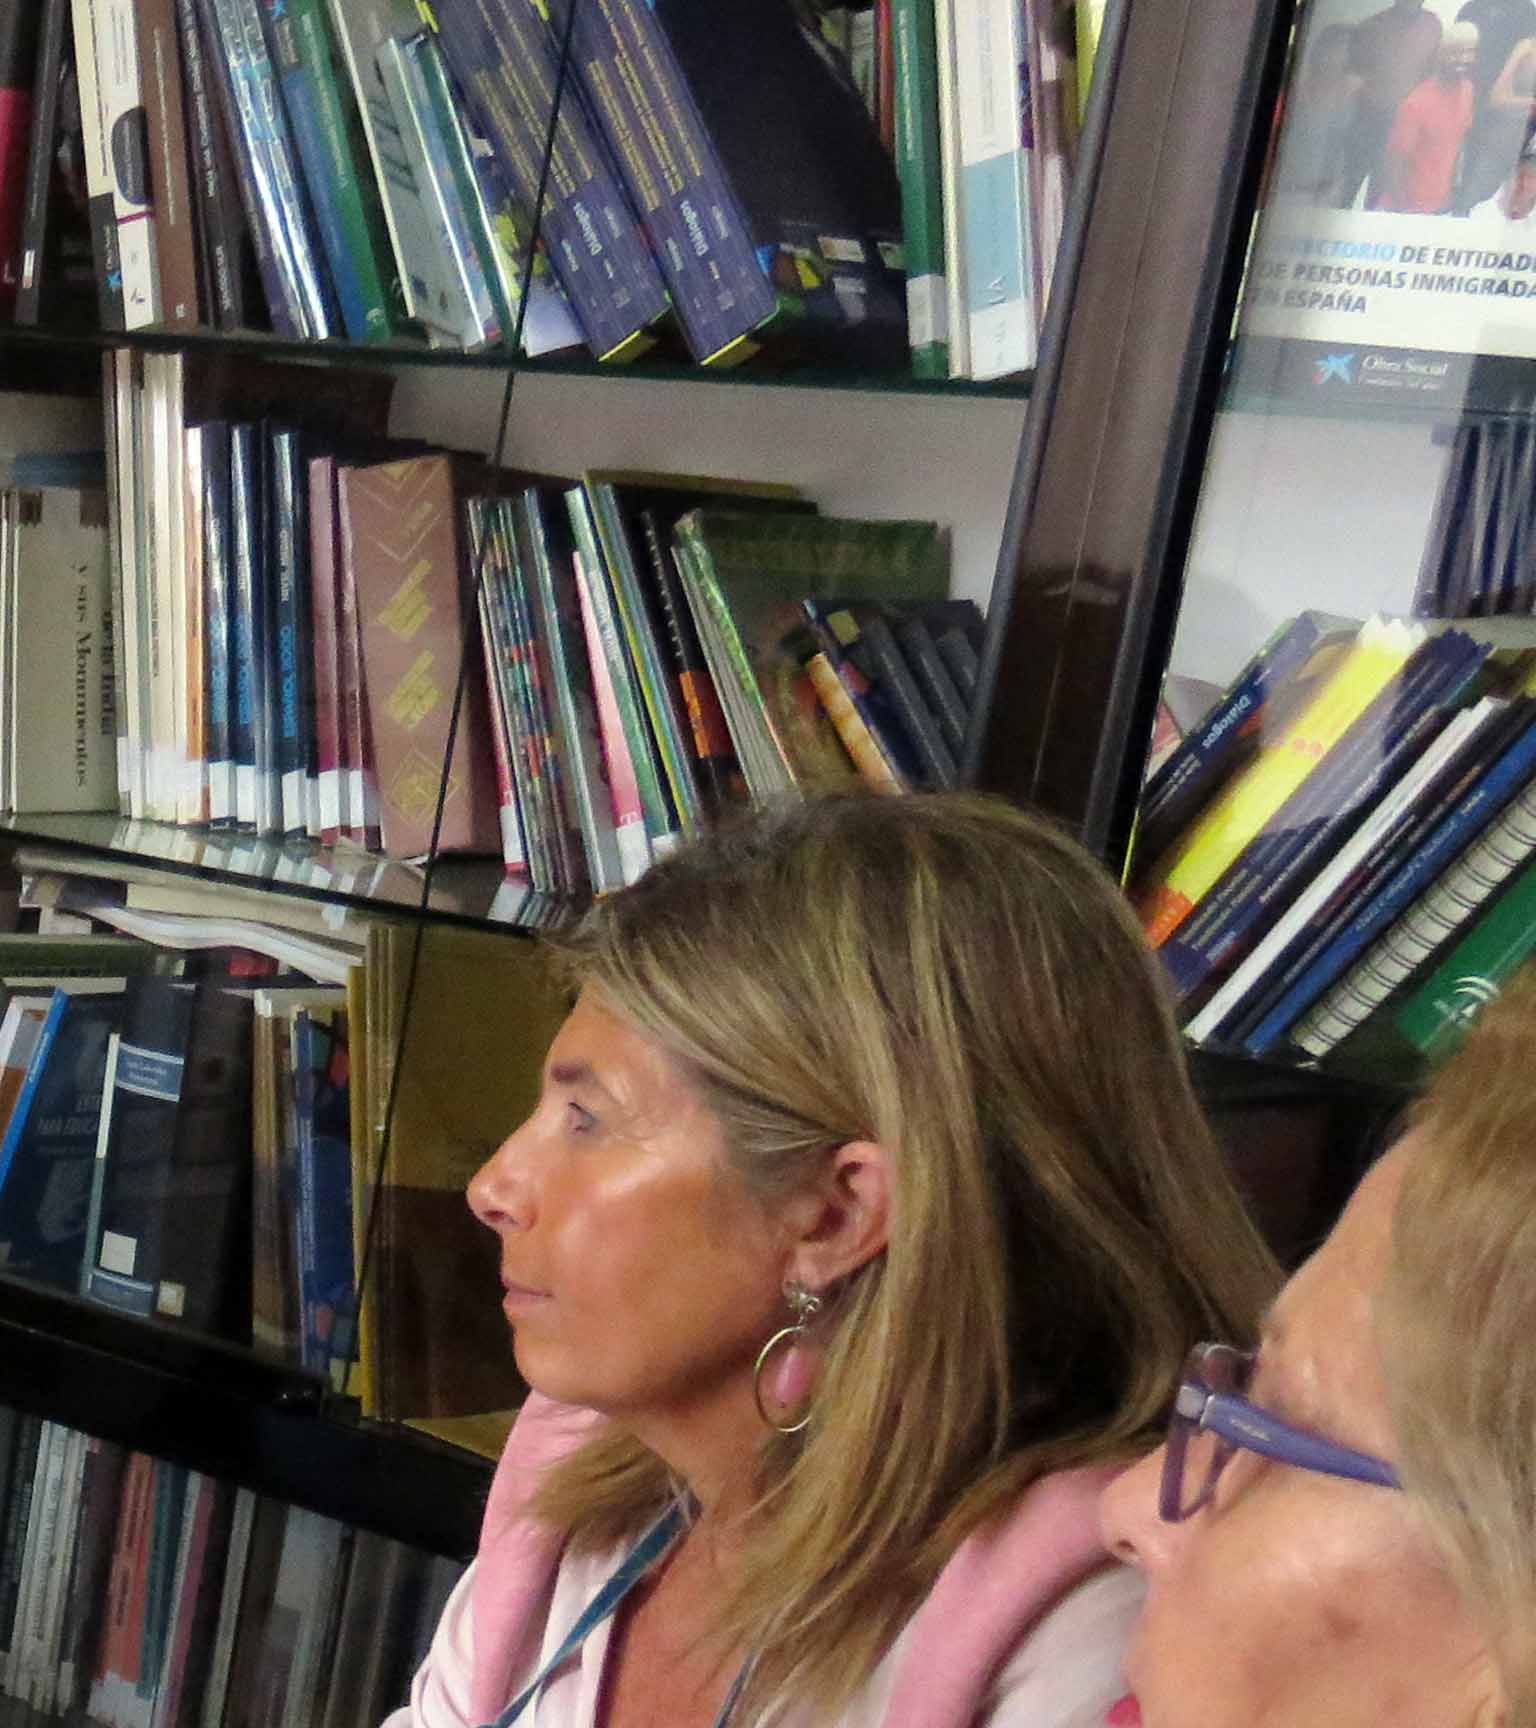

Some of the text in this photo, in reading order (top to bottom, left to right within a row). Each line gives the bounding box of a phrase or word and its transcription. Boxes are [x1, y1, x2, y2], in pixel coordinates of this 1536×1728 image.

[1399, 245, 1433, 264] DE
[1293, 265, 1408, 290] PERSONAS
[1284, 289, 1367, 313] ESPAÑA
[77, 584, 89, 623] sus
[74, 631, 93, 788] Monumentos
